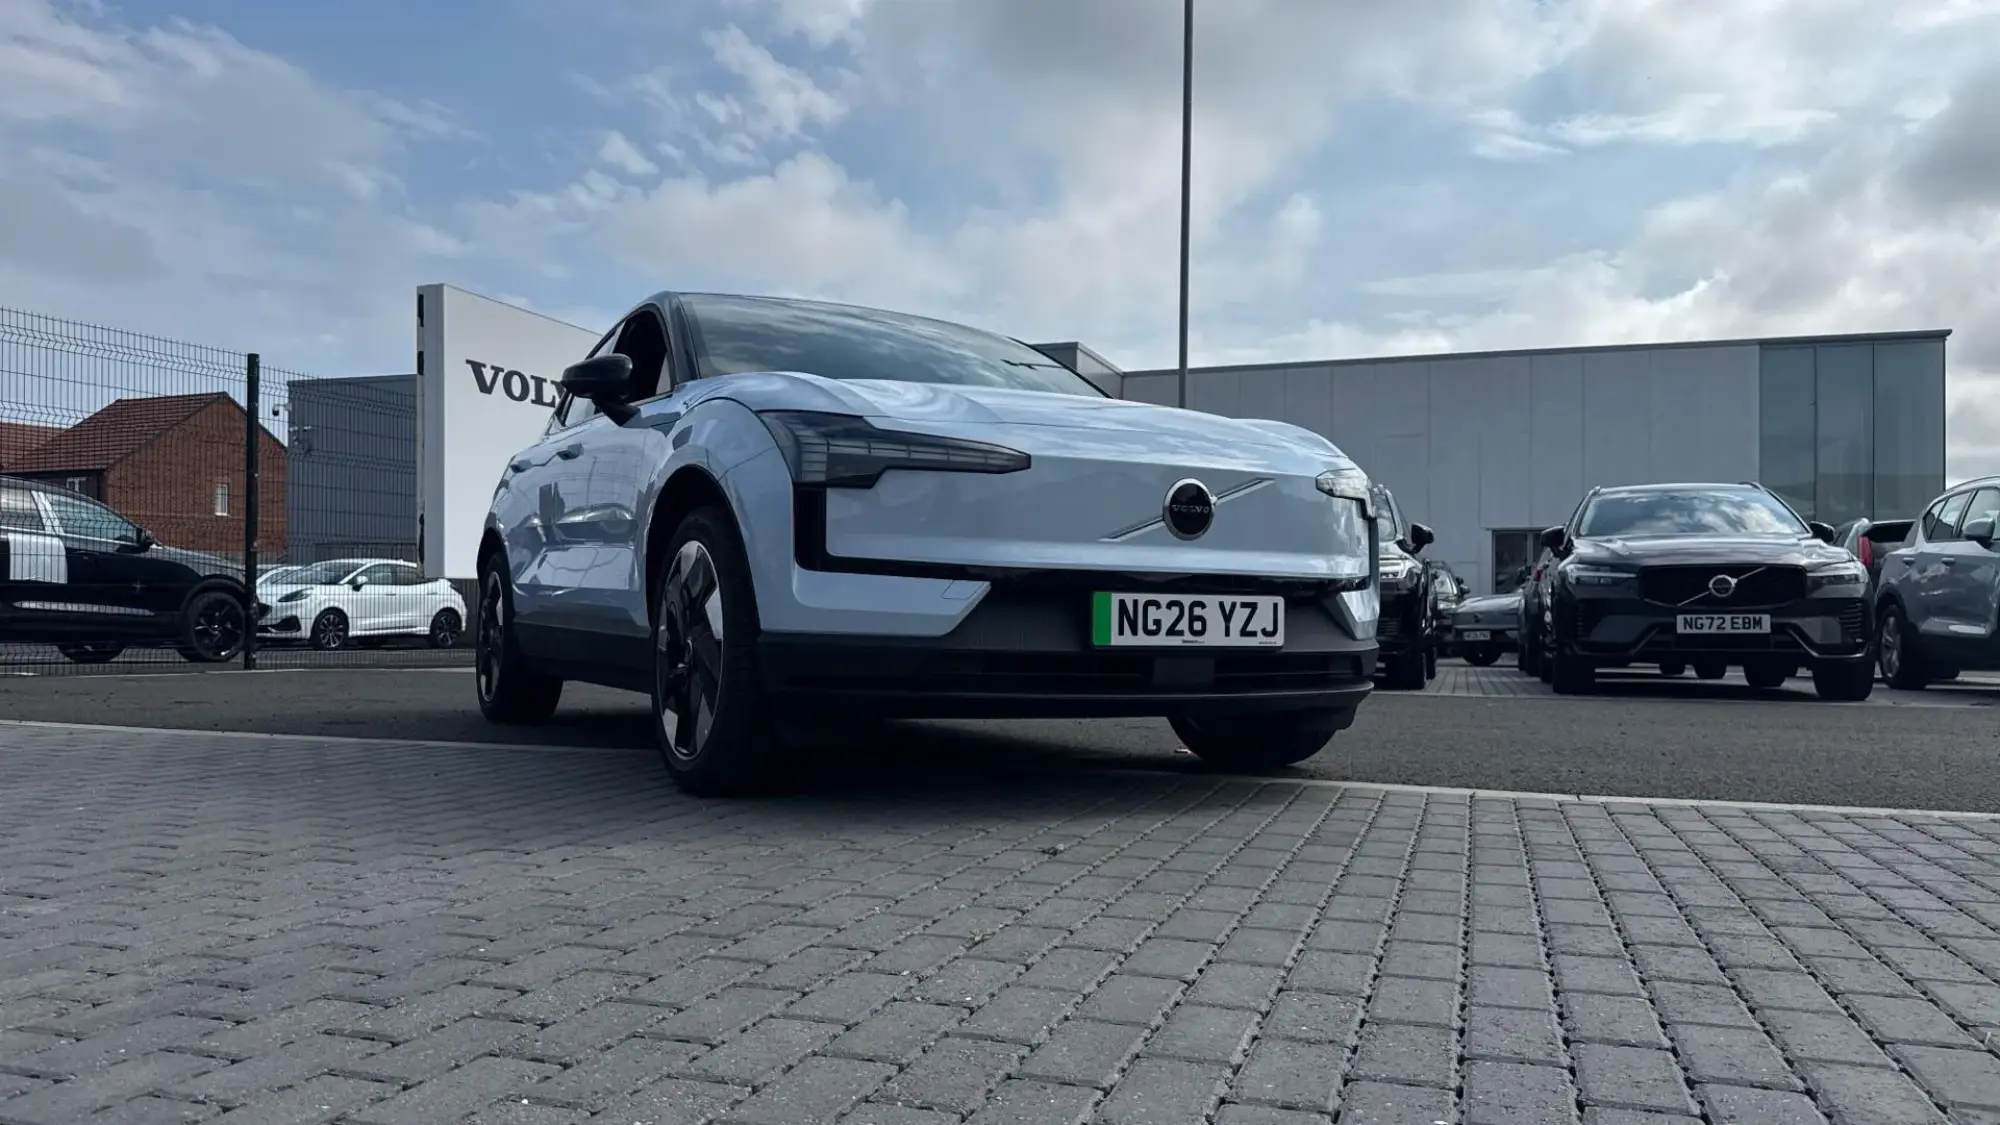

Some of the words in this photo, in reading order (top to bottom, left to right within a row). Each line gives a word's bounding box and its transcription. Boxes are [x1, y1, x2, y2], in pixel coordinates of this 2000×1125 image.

[1117, 598, 1207, 637] NG26
[1218, 600, 1279, 638] YZJ
[1683, 616, 1726, 631] NG72
[1730, 616, 1763, 630] EBM
